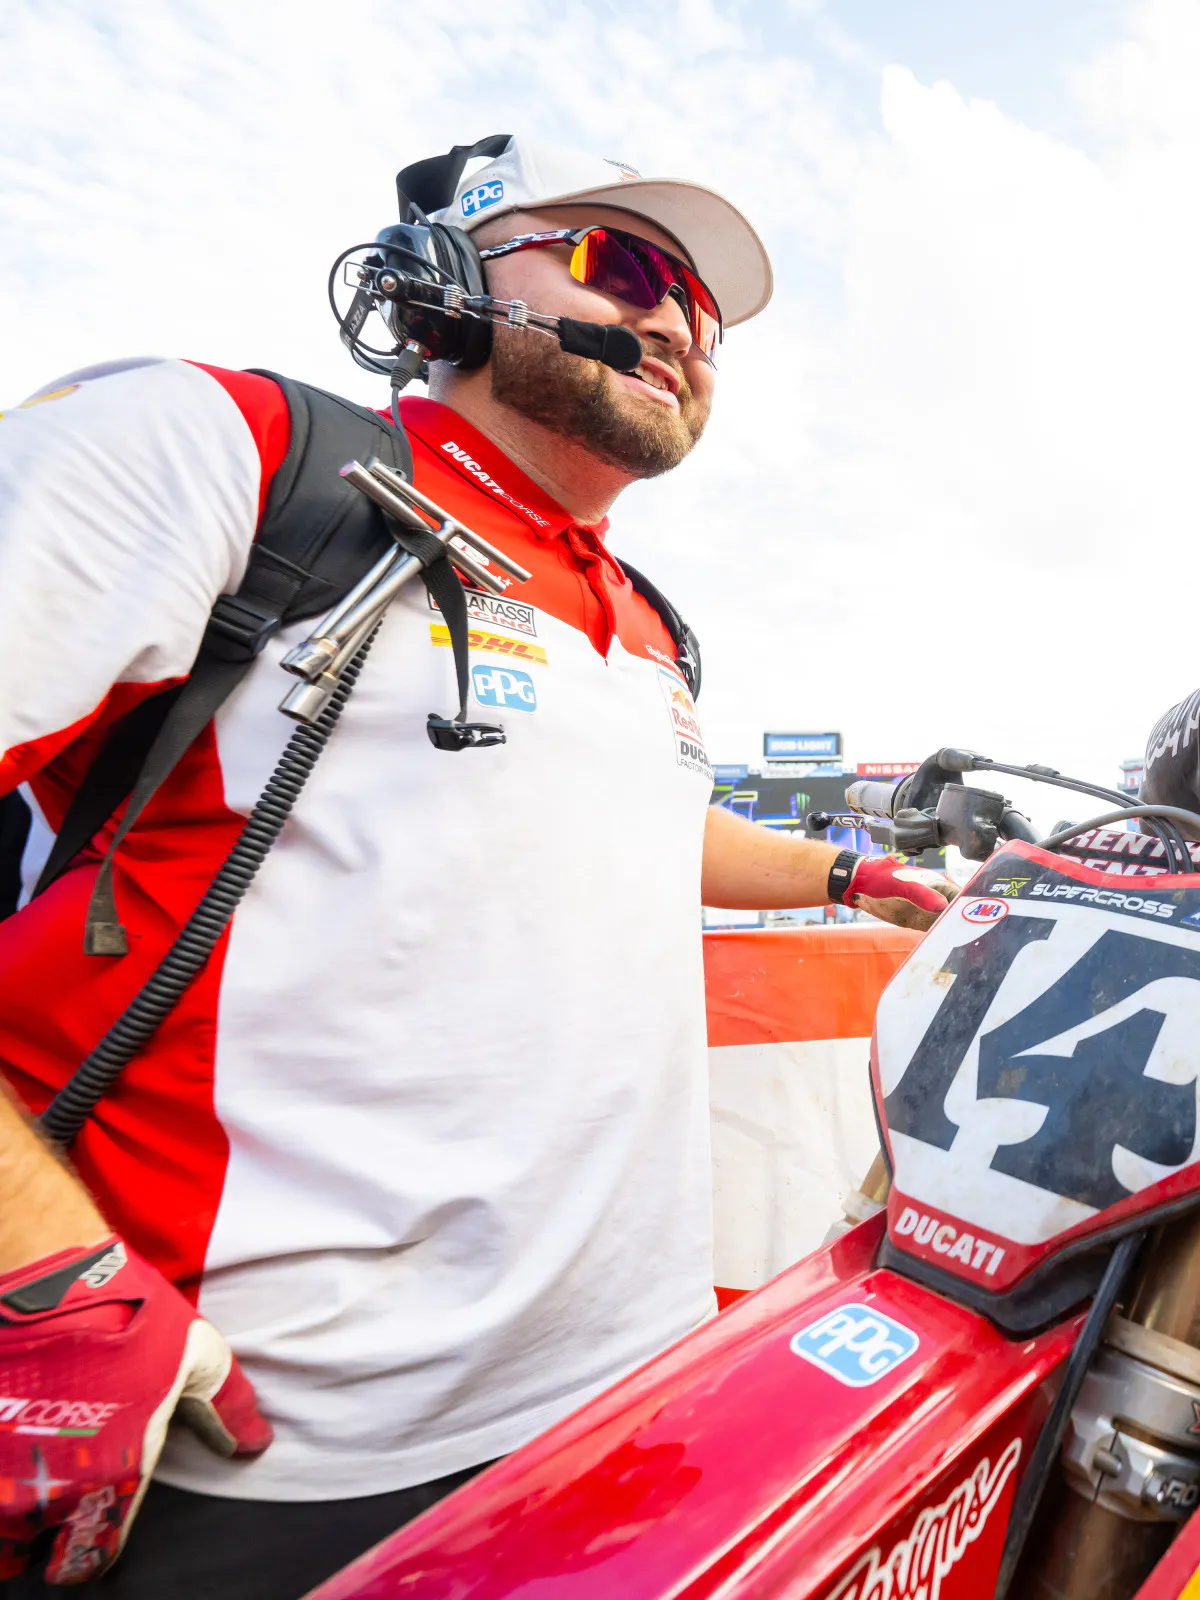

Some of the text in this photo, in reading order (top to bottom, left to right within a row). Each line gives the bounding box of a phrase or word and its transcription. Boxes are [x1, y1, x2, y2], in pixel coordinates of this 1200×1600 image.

[463, 184, 503, 213] PPG
[441, 441, 551, 527] DUCATI CORSE
[467, 596, 531, 624] ANASSI
[468, 632, 534, 659] DHL
[473, 670, 535, 704] PPG
[680, 740, 713, 769] DUCA
[865, 763, 918, 774] NISSA
[831, 816, 864, 828] ASV
[968, 902, 1002, 918] AMA
[989, 880, 1177, 918] SMX SUPERCROSS
[894, 1207, 1005, 1277] DUCATI
[809, 1313, 905, 1375] PPG
[16, 1399, 118, 1428] CORSE
